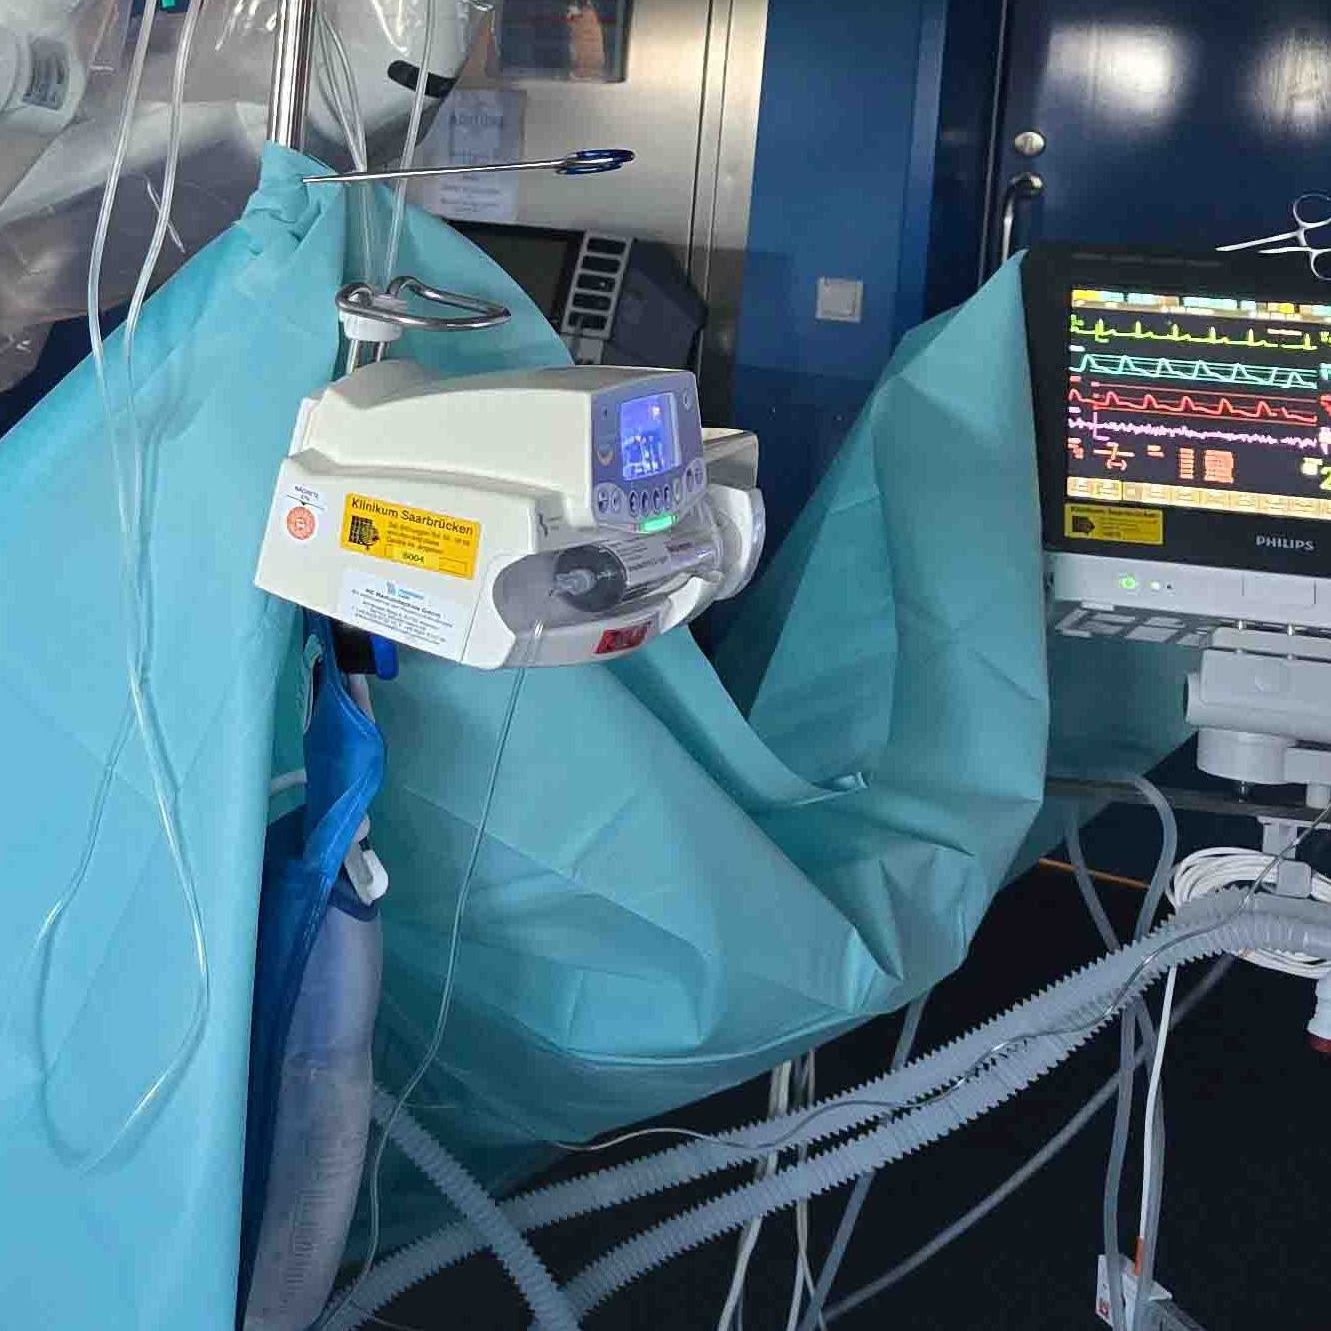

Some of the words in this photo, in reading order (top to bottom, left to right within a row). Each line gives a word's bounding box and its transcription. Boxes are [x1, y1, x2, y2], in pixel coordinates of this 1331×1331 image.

[351, 497, 399, 518] Klinikum
[400, 509, 474, 535] Saarbrücken
[1256, 535, 1314, 551] PHILIPS
